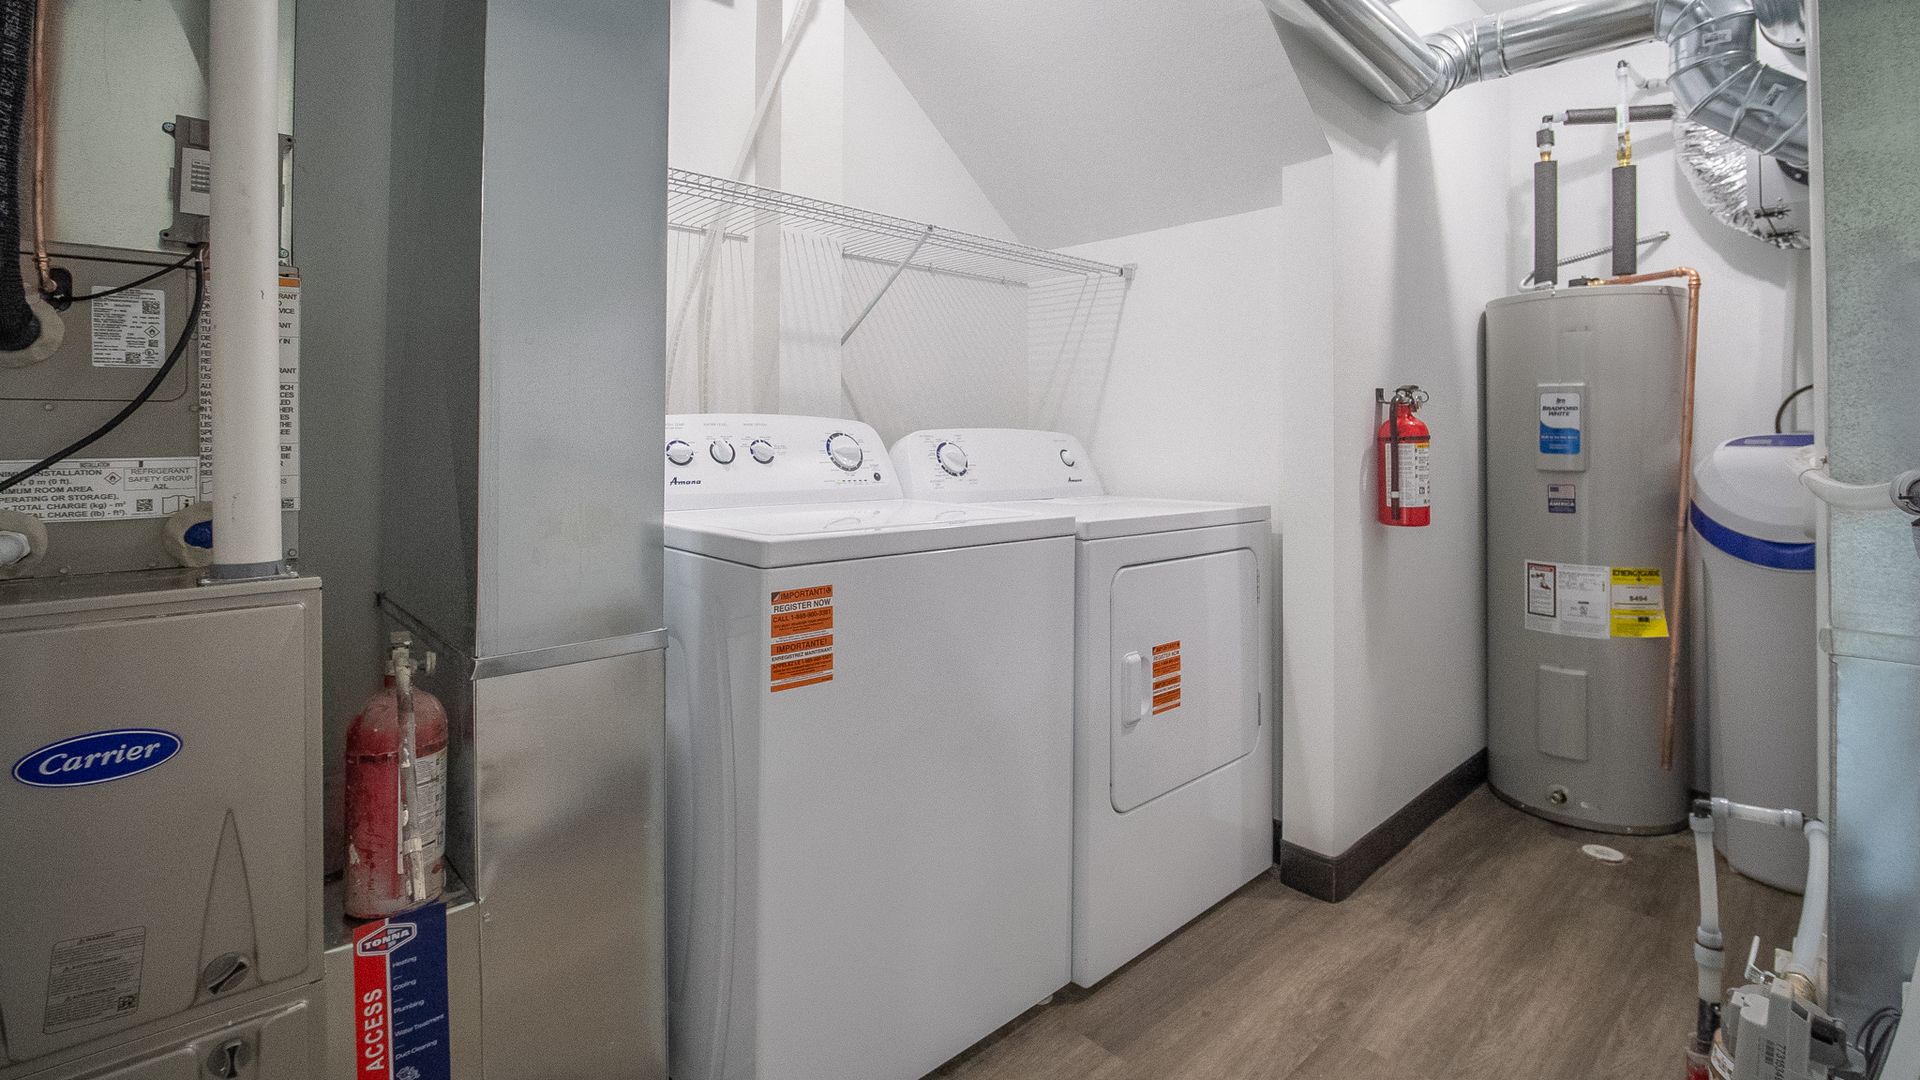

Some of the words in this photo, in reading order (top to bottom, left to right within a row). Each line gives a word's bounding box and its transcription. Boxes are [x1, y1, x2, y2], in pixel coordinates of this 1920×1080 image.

[131, 467, 190, 475] REFRIGERANT
[128, 475, 161, 483] SAFETY
[163, 474, 193, 482] GROUP
[669, 476, 702, 486] Amana
[34, 486, 65, 494] ROOM
[66, 485, 94, 493] AREA
[51, 494, 66, 502] OR
[12, 504, 45, 512] TOTAL
[46, 502, 88, 510] CHARGE
[47, 510, 89, 519] CHARGE
[773, 600, 812, 613] REGISTER
[813, 598, 832, 608] NOW
[773, 614, 790, 623] CALL
[38, 741, 161, 776] Carrier
[364, 930, 410, 949] TONNA
[392, 956, 416, 967] Heating
[392, 978, 417, 992] Cooling
[393, 999, 425, 1013] Plumbing
[363, 988, 384, 1071] ACCESS
[394, 1026, 414, 1036] Water
[414, 1014, 444, 1029] Treatment
[395, 1048, 411, 1061] Duct
[411, 1039, 438, 1054] Cleaning
